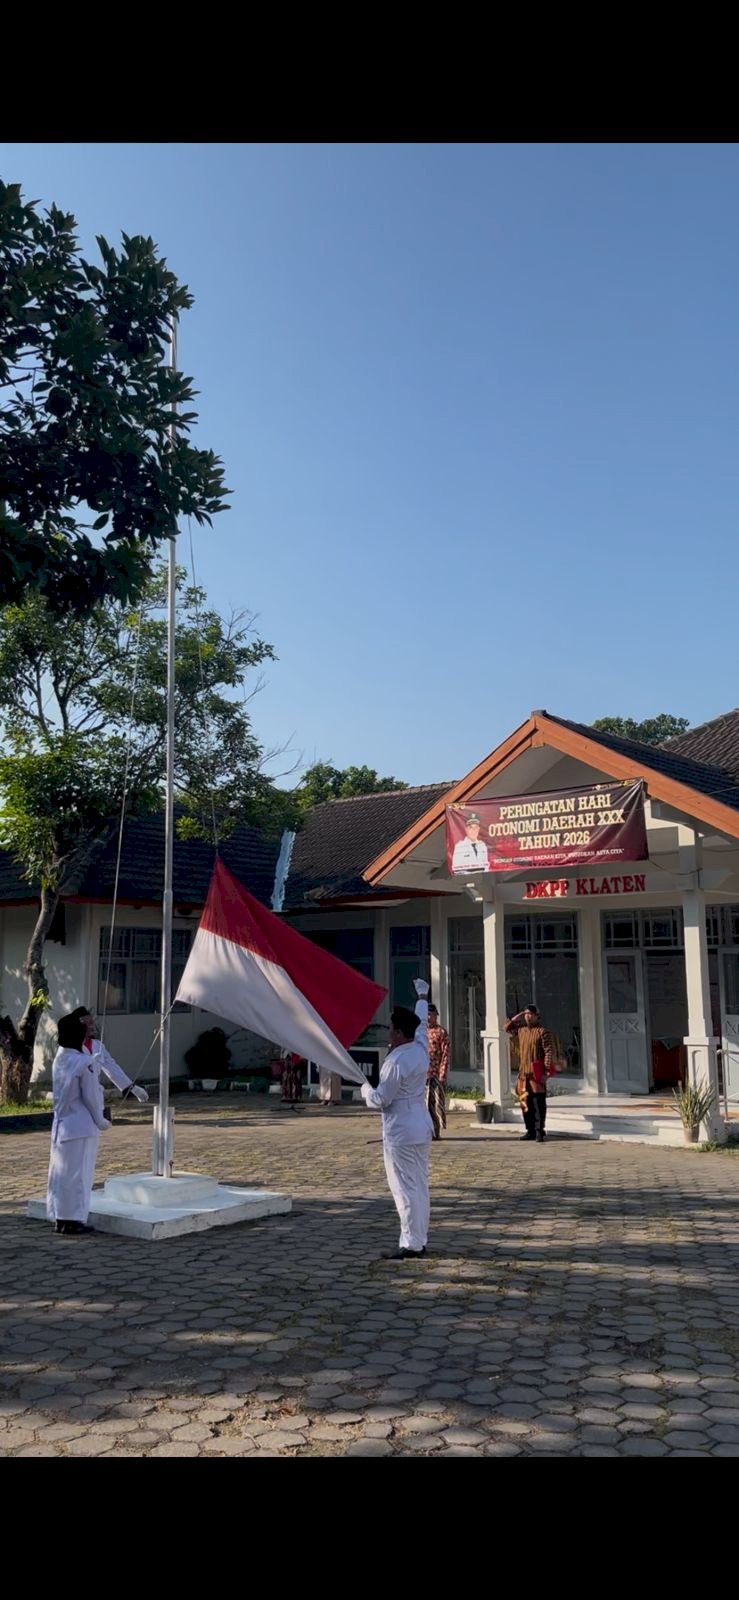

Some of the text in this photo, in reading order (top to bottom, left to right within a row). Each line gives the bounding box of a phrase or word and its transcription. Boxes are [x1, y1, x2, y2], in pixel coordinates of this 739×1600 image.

[499, 793, 611, 820] PERINGATAN HARI
[488, 808, 625, 837] OTONOMI DAERAH XXX
[518, 830, 591, 850] TAHUN 2026
[525, 875, 646, 899] DKPP KLATEN
